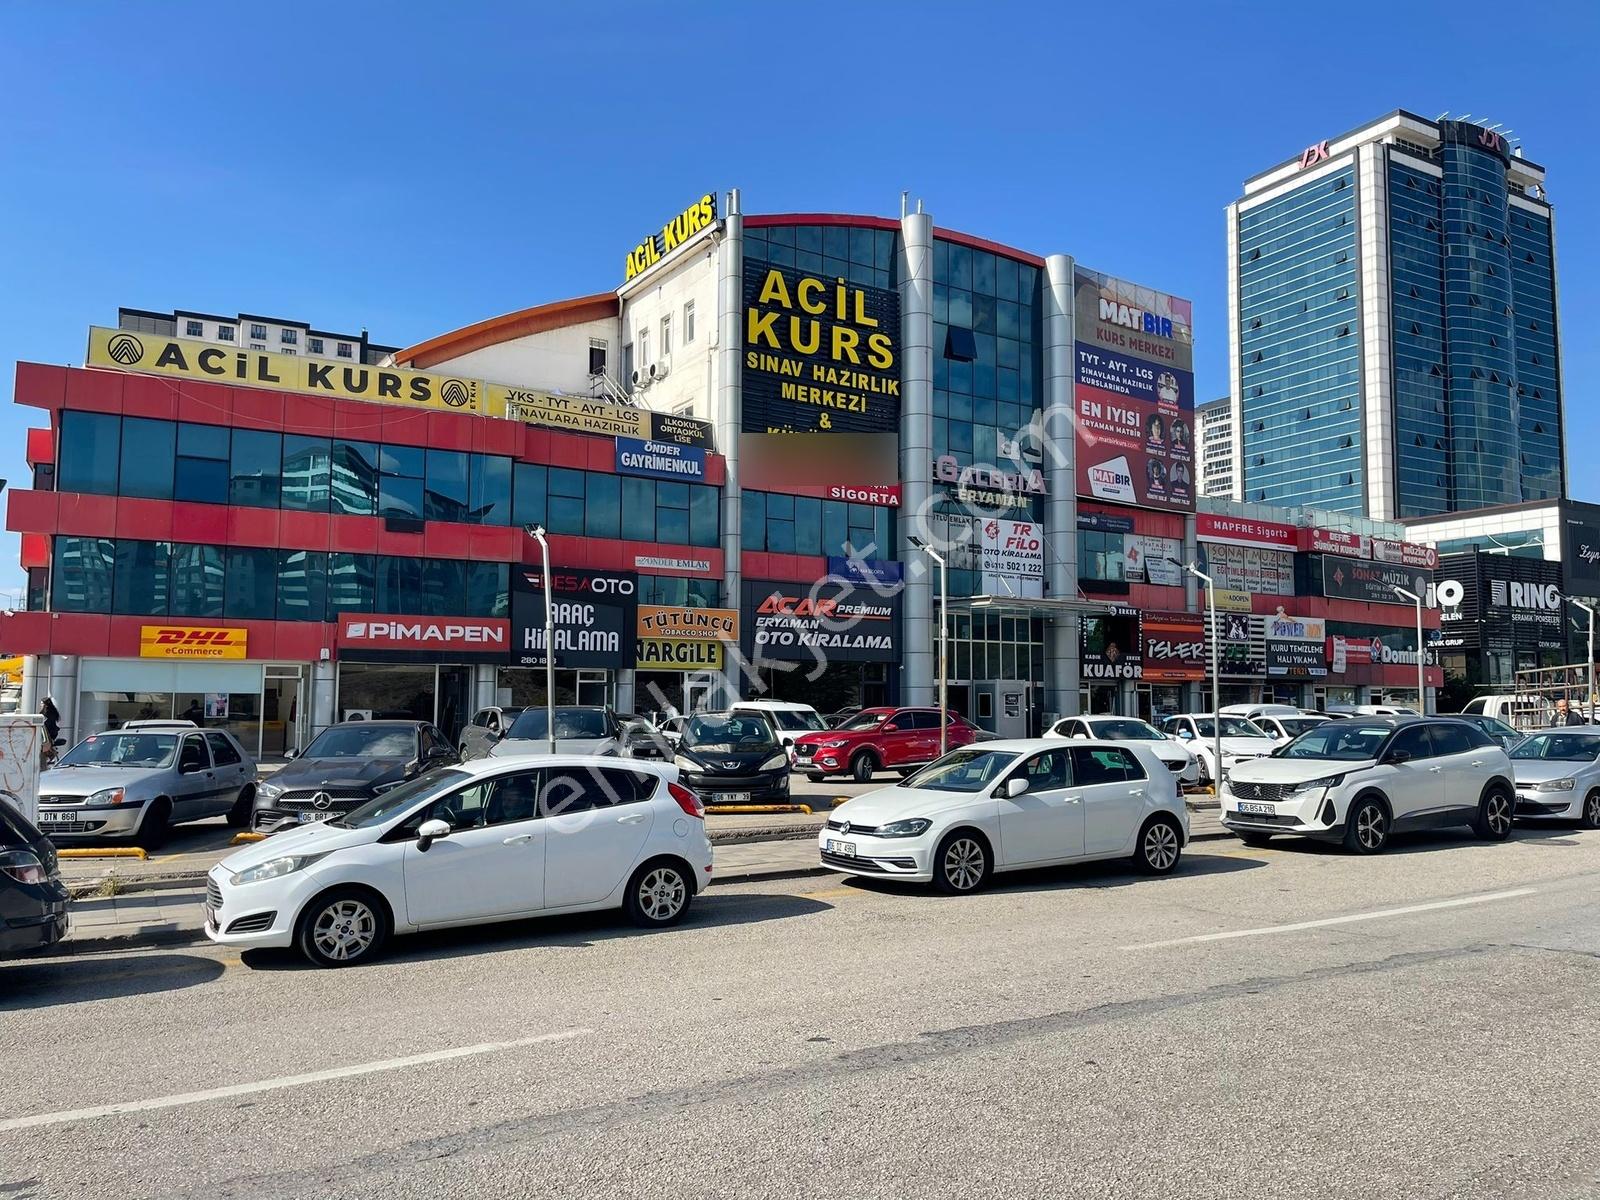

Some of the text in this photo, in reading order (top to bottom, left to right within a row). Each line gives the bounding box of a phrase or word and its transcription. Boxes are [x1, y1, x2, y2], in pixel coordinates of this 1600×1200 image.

[664, 193, 714, 253] KURS
[748, 308, 894, 369] KURS
[1096, 328, 1126, 347] KURS
[747, 352, 900, 396] SINAV HAZIRLIK
[1080, 351, 1099, 365] TYT
[1108, 360, 1127, 373] AYT
[1136, 367, 1153, 380] LGS
[308, 363, 432, 401] KURS
[1081, 366, 1120, 383] SINAVLARA
[1081, 375, 1130, 394] KURSLARINDA
[508, 389, 534, 404] YKS
[546, 397, 570, 411] TYT
[581, 404, 605, 417] AYT
[616, 409, 639, 422] LGS
[782, 383, 867, 412] MERKEZİ
[1081, 400, 1101, 418] EN
[584, 418, 639, 435] HAZIRLIK
[819, 412, 832, 429] &
[1082, 418, 1113, 432] ERYAMAN
[644, 441, 681, 456] ÖNDER
[621, 452, 702, 475] GAYRİMENKUL
[831, 486, 899, 504] SİGORTA
[959, 489, 1028, 508] ERYAMAN
[1012, 523, 1031, 537] TR
[1213, 520, 1288, 538] MAPFRE Sigorta
[984, 548, 1000, 556] OTO
[677, 560, 708, 569] EMLAK
[1006, 561, 1020, 571] 502
[1028, 563, 1042, 573] 222
[836, 604, 891, 616] PREMIUM
[642, 609, 734, 632] TÜTÜNCÜ
[156, 630, 233, 646] DHL
[661, 628, 718, 637] TOBACCO SHOP
[755, 630, 893, 649] OTO KİRALAMA
[165, 646, 223, 656] eCommerce
[1271, 643, 1288, 653] KURU
[1381, 645, 1433, 665] Domin's
[1277, 655, 1292, 664] HALI
[1083, 662, 1143, 678] KUAFÖR
[61, 812, 75, 820] 868
[302, 812, 311, 823] 06
[1250, 804, 1263, 813] BSA
[1263, 805, 1275, 814] 216
